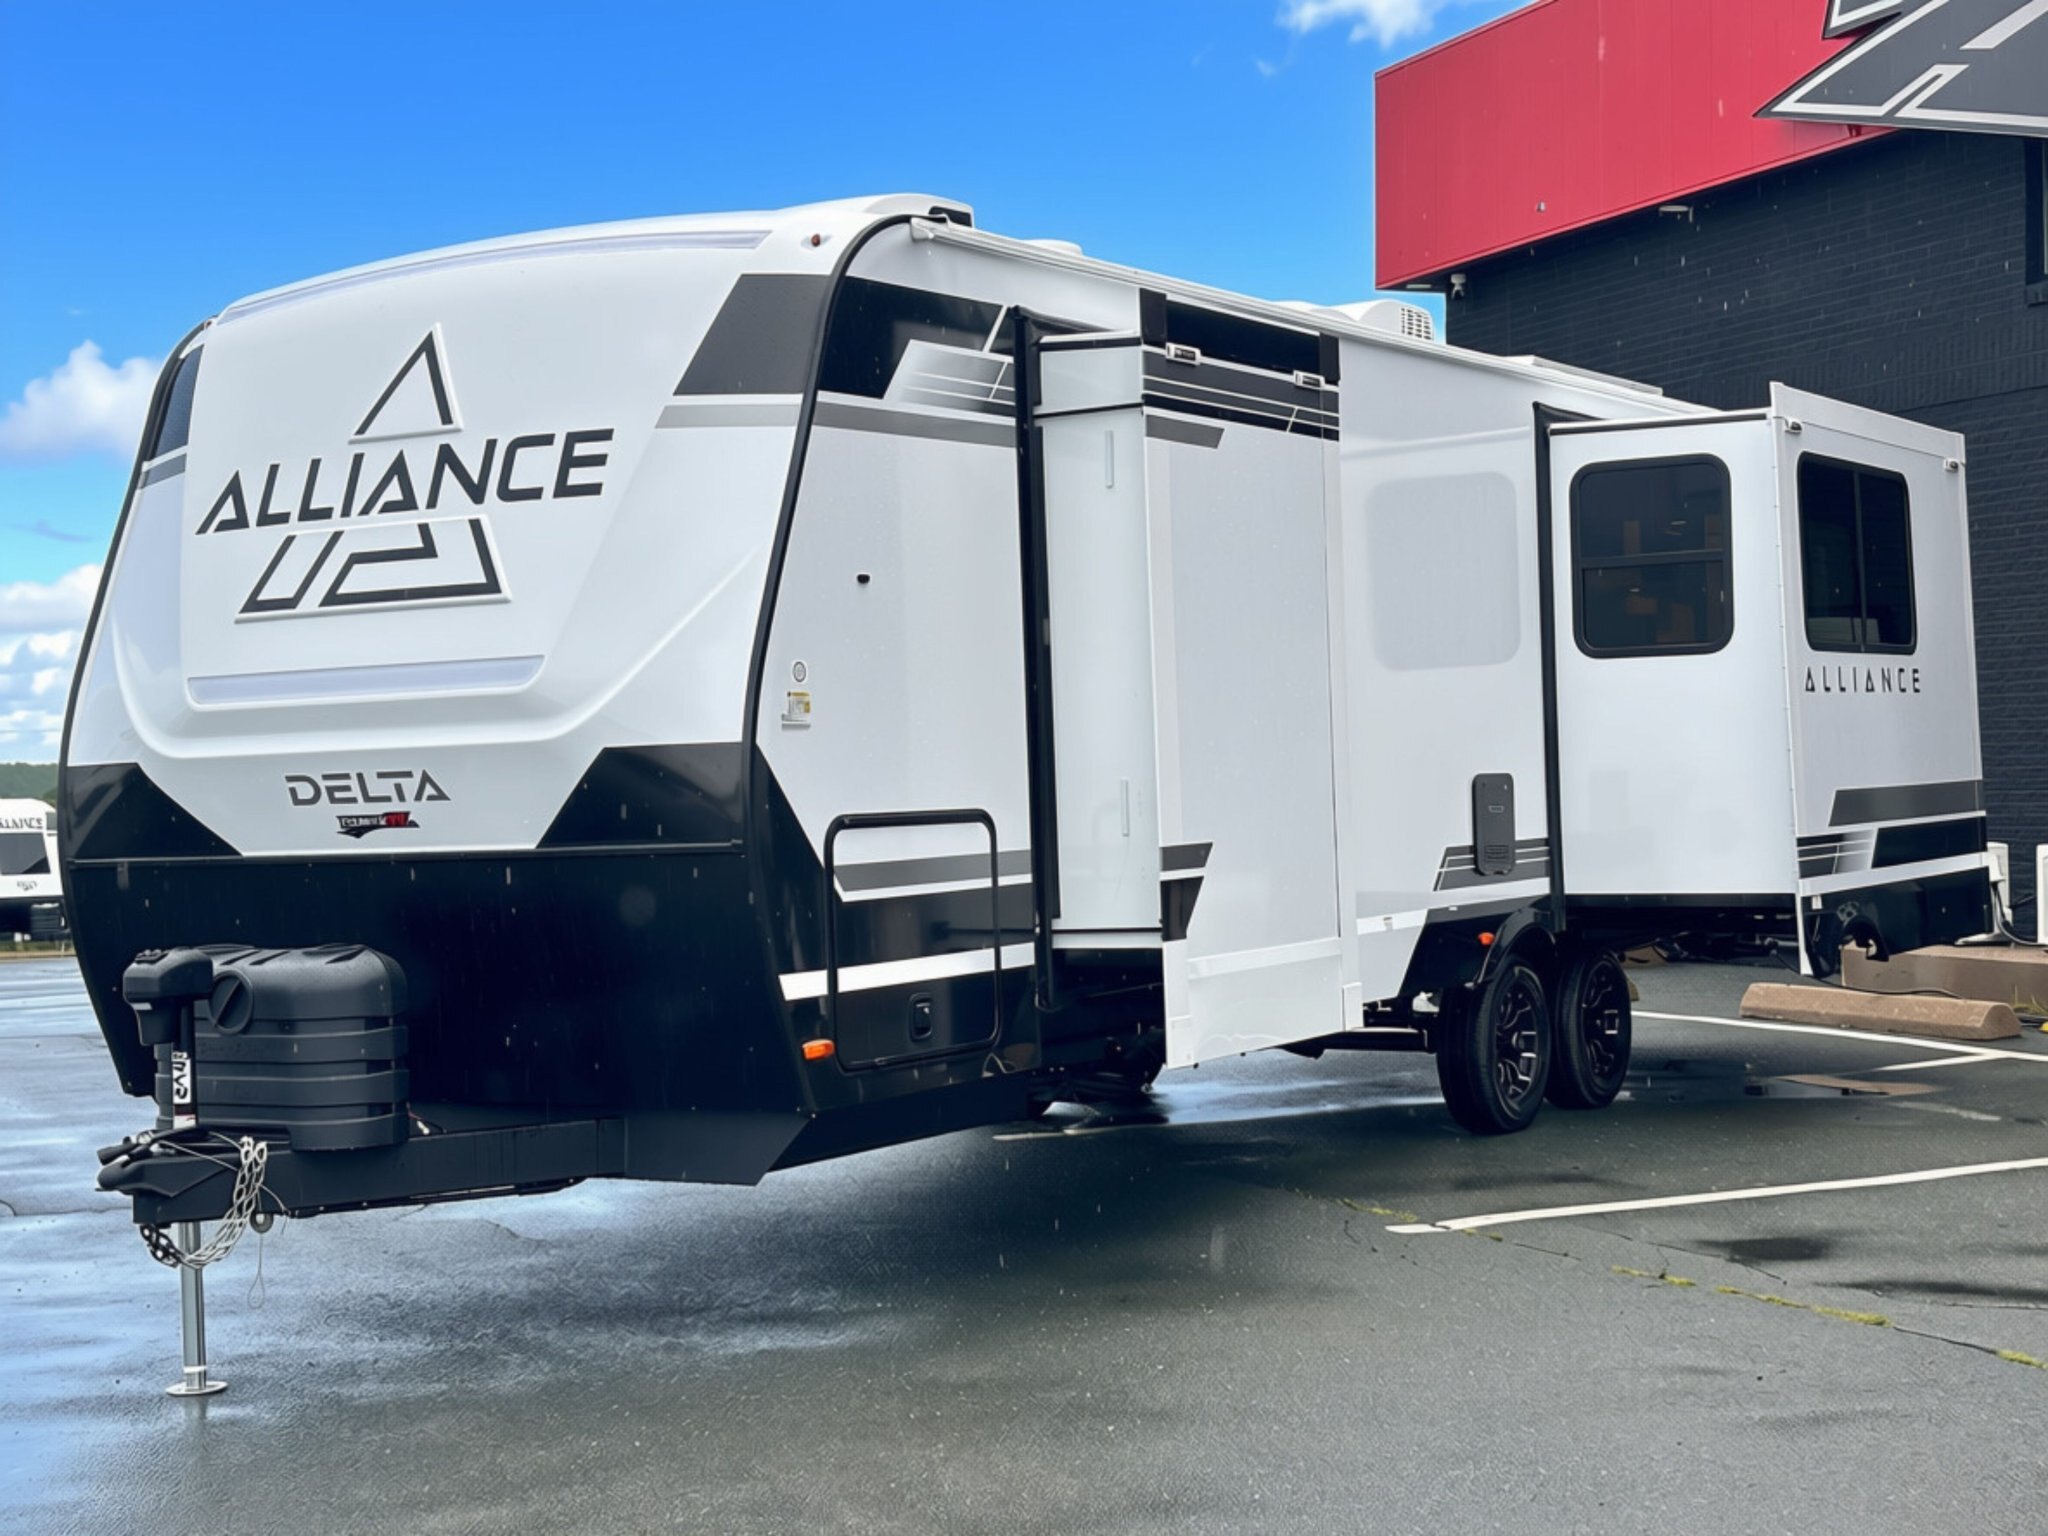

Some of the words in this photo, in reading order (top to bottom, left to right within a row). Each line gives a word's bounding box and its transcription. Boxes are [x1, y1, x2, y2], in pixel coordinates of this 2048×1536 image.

[195, 428, 615, 535] ALLIANCE
[1804, 665, 1921, 693] ALLIANCE
[284, 769, 452, 806] DELTA
